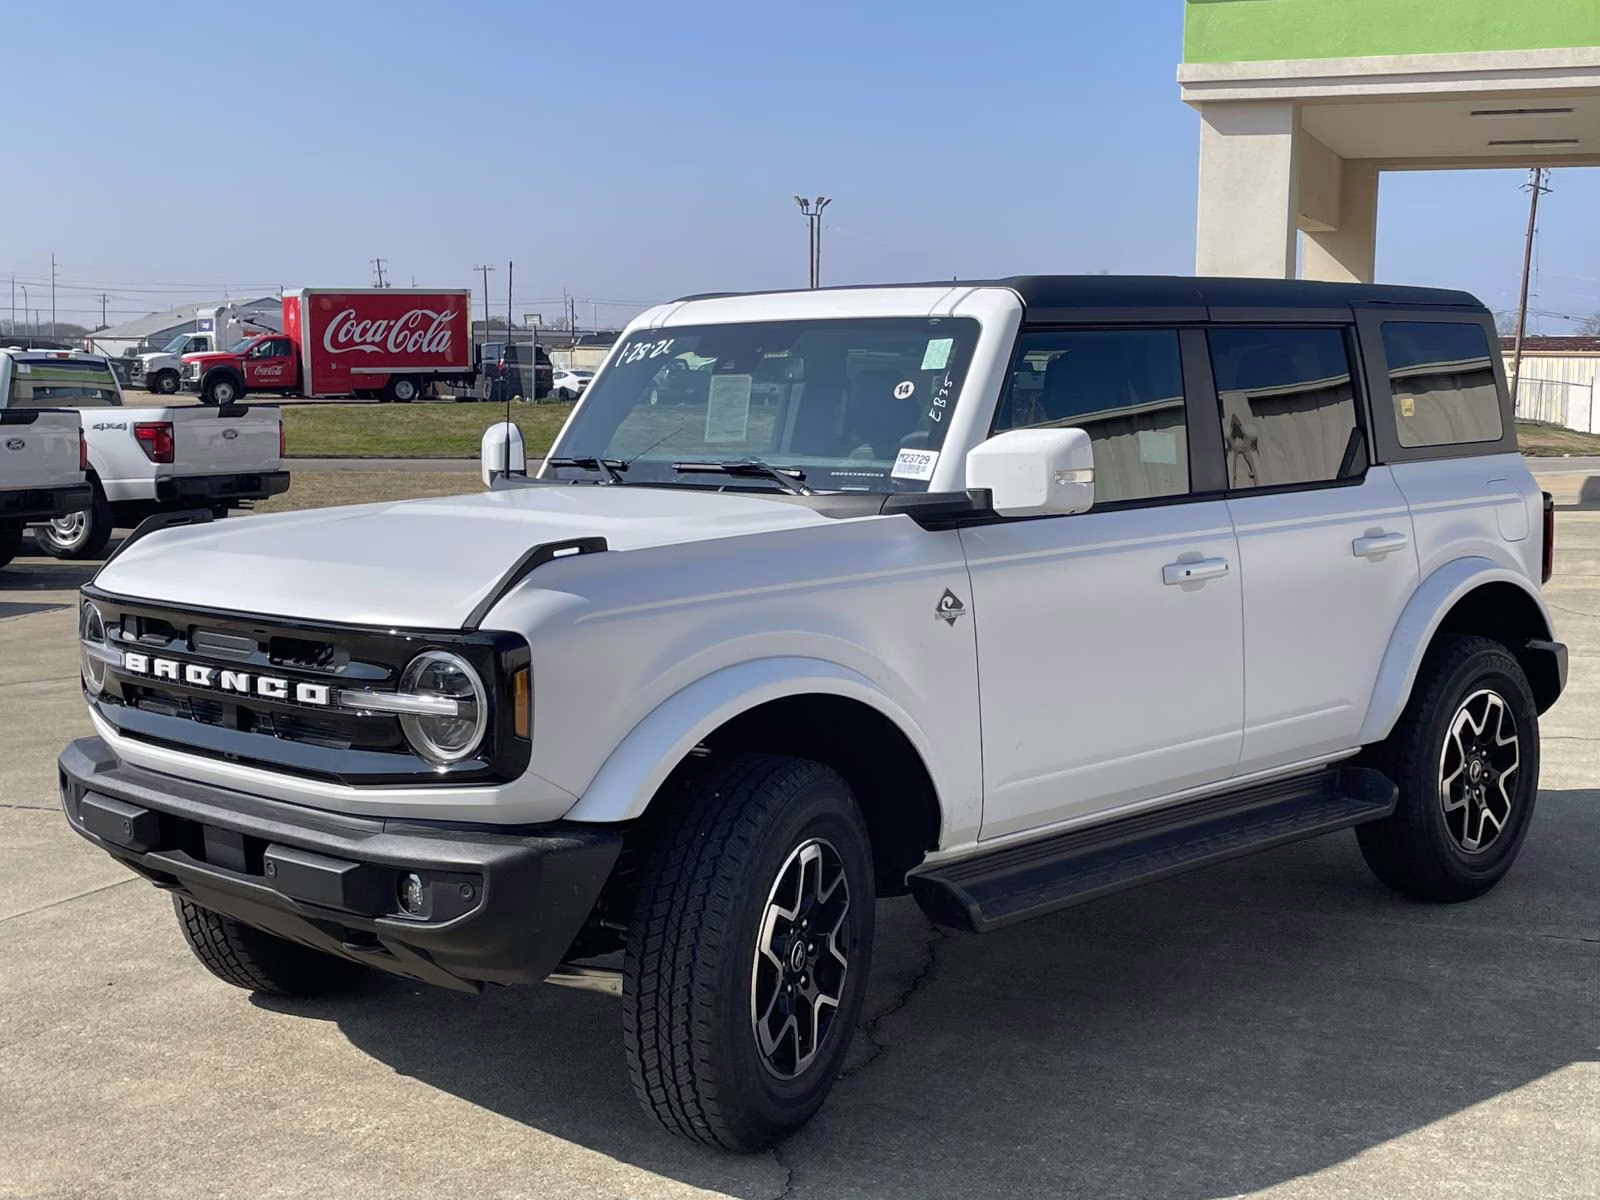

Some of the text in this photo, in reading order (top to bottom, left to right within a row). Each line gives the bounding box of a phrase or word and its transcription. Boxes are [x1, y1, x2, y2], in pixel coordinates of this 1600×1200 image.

[323, 309, 459, 354] Coca-Cola
[898, 384, 910, 396] 14
[898, 453, 931, 465] M23729
[125, 652, 330, 706] BRONCO
